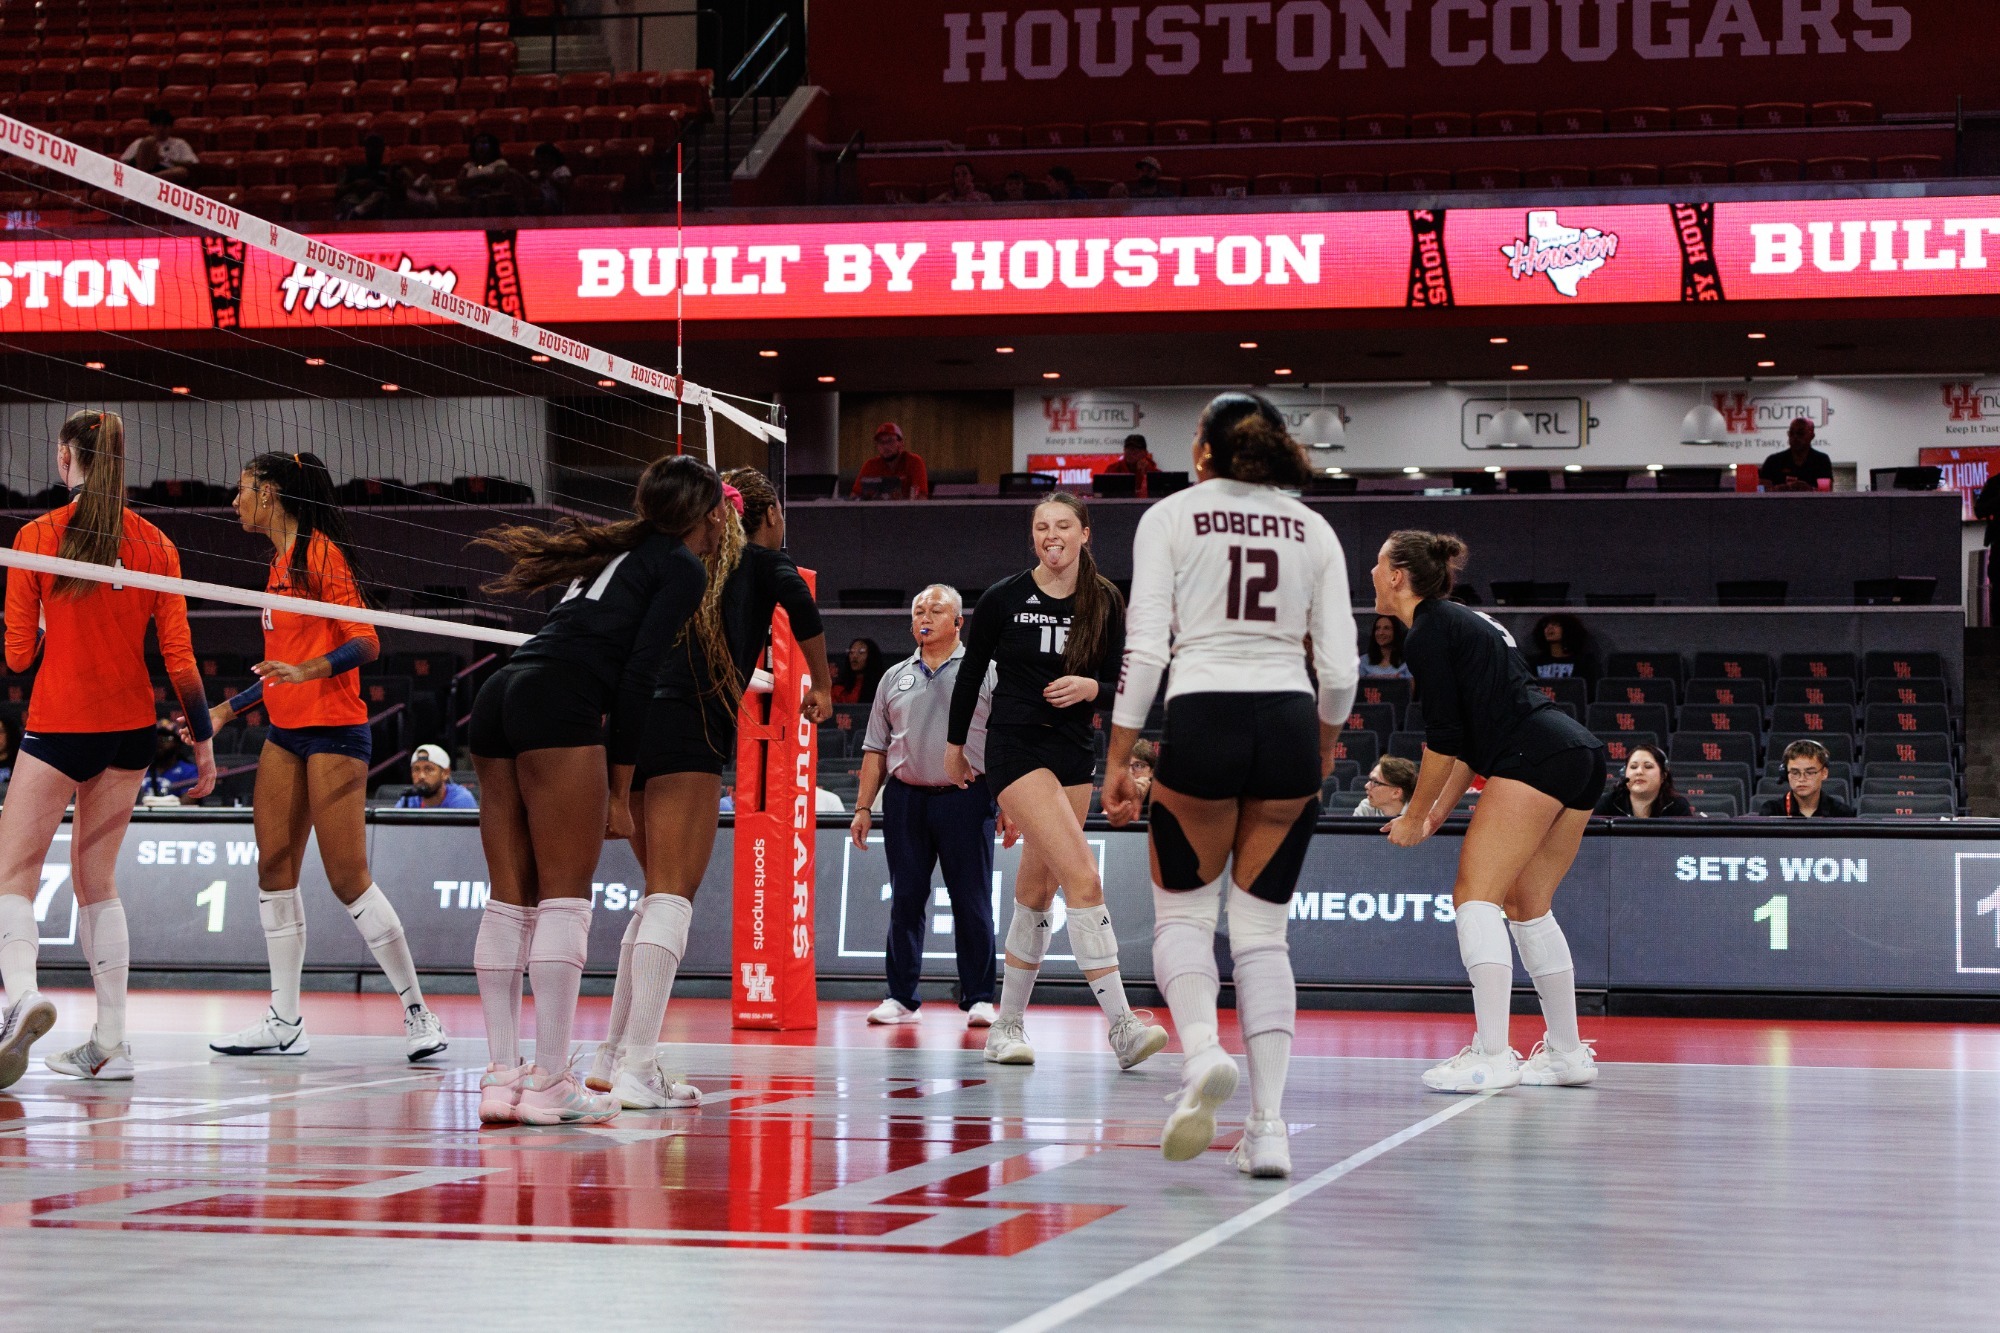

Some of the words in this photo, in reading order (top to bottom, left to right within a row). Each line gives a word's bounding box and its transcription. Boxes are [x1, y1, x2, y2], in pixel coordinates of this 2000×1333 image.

[943, 0, 1411, 83] HOUSTON
[1431, 0, 1912, 67] COUGARS
[577, 245, 800, 298] BUILT
[824, 242, 927, 294] BY
[951, 234, 1325, 291] HOUSTON
[1508, 233, 1618, 279] Houston
[1750, 217, 2000, 275] BUILT
[0, 258, 160, 309] TON
[157, 182, 240, 230] HOUSTON
[306, 241, 376, 283] HOUSTON
[431, 289, 491, 326] HOUSTON
[539, 330, 590, 362] HOUSTON
[1042, 396, 1079, 432] UH
[1711, 390, 1758, 433] UH
[1942, 383, 1984, 421] UH
[1946, 425, 1968, 434] Keep
[1193, 511, 1305, 542] BOBCATS
[1226, 546, 1279, 622] 12
[1013, 612, 1057, 624] TEXAS
[137, 840, 217, 865] SETS
[753, 838, 766, 888] sports
[1675, 855, 1769, 882] SETS
[1779, 857, 1868, 883] WON
[196, 880, 227, 932] 1
[1754, 894, 1788, 950] 1
[741, 963, 775, 1002] UH
